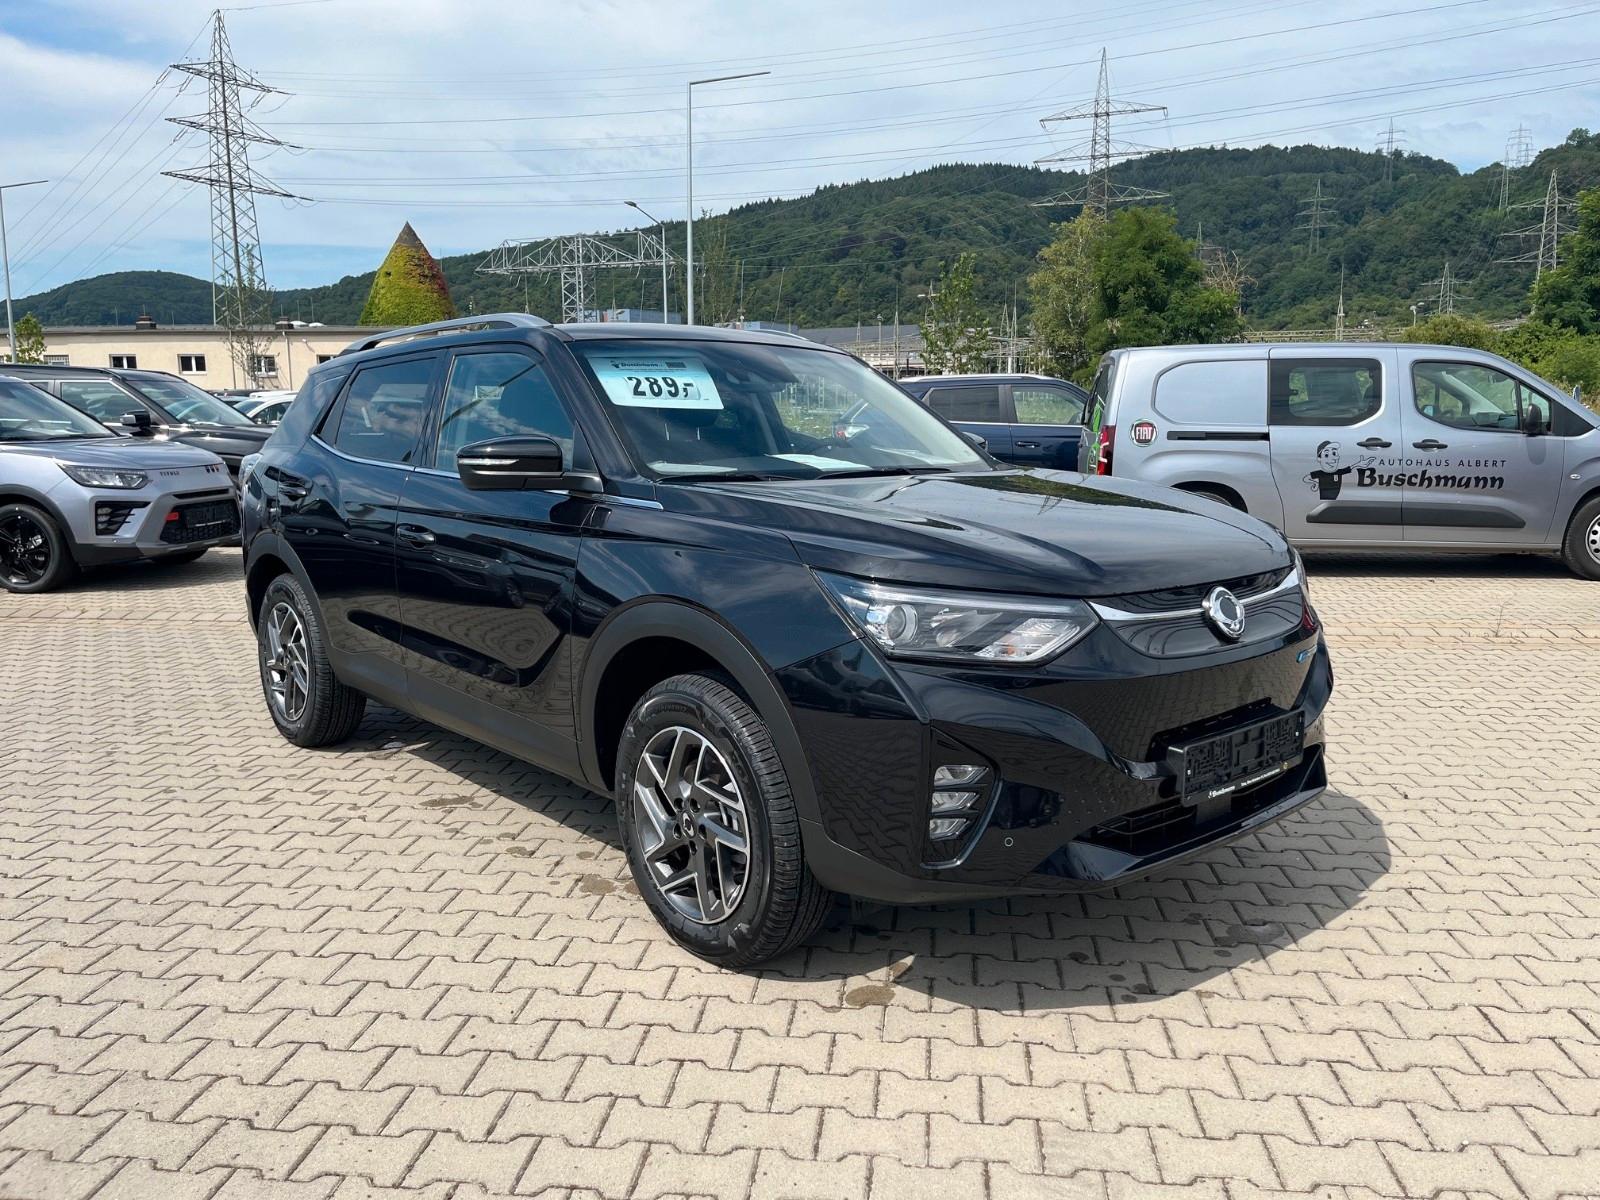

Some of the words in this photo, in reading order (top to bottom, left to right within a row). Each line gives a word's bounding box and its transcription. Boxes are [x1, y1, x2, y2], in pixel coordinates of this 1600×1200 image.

[1136, 427, 1153, 439] FIAT
[1378, 458, 1450, 467] AUTOHAUS
[1457, 459, 1507, 467] ALBERT
[1357, 467, 1504, 489] Buschmann
